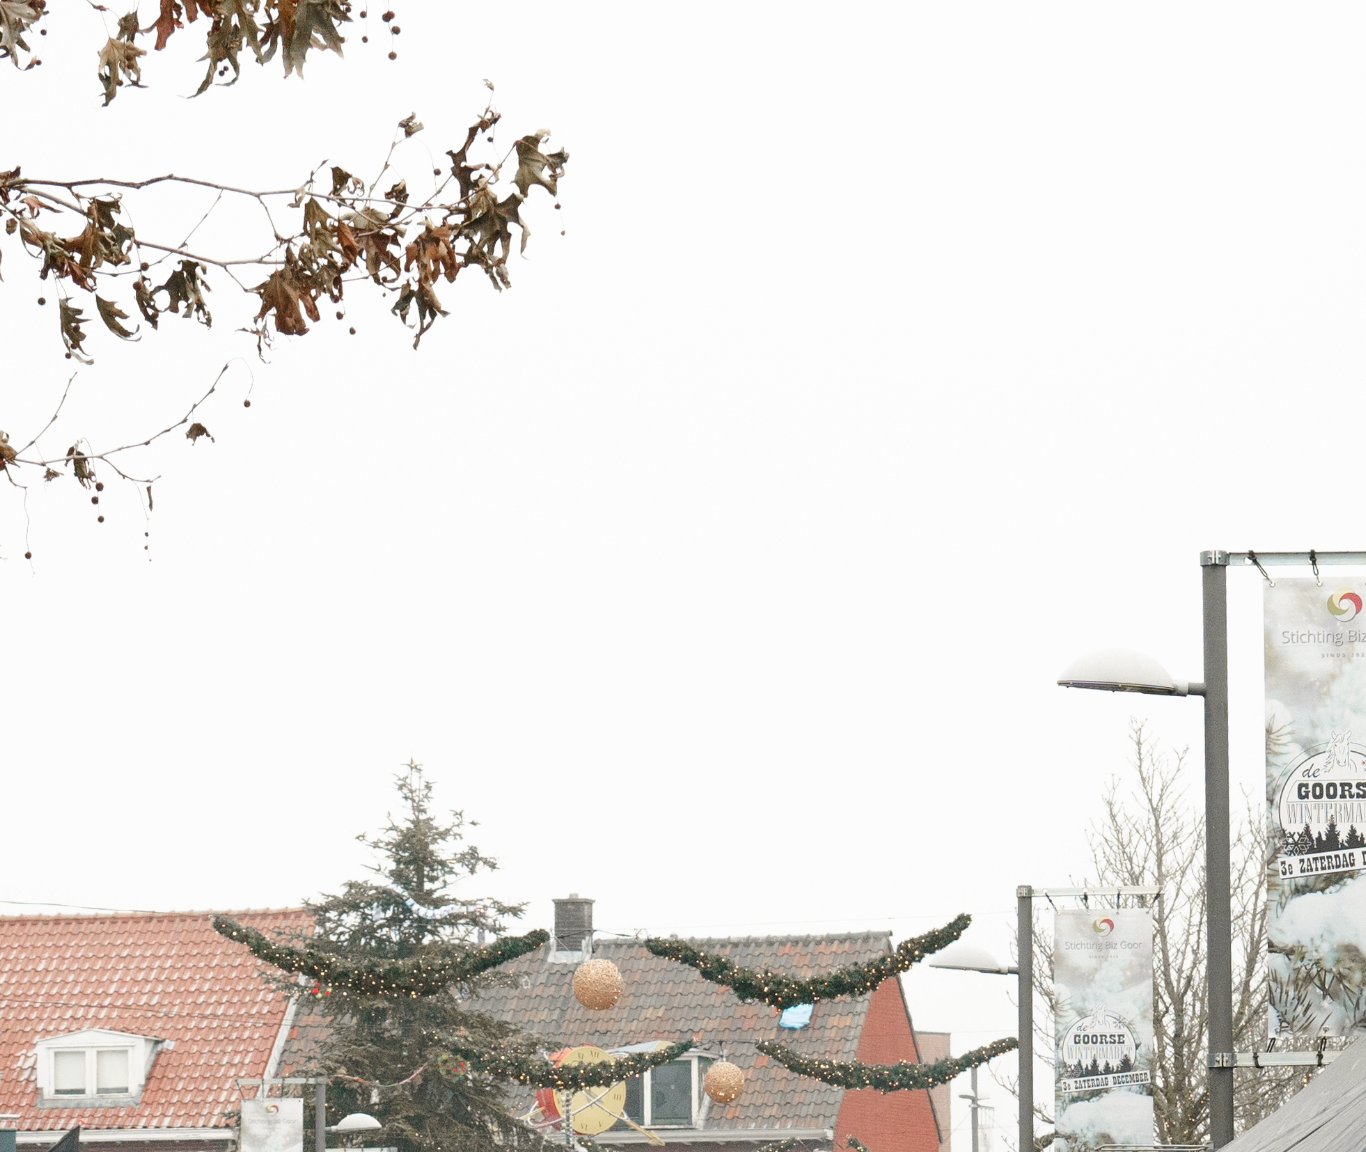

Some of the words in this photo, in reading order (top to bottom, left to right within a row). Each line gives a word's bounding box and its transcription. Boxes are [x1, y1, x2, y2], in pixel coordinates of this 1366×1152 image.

[1281, 630, 1343, 647] Stichting
[1302, 763, 1320, 778] de
[1280, 860, 1293, 876] 3e
[1299, 852, 1355, 873] ZATERDAG
[1065, 941, 1103, 951] Stichting
[1120, 940, 1143, 949] Goor
[1073, 1034, 1125, 1045] GOORSE
[1062, 1081, 1071, 1091] 3e
[1074, 1077, 1109, 1090] ZATERDAG
[1112, 1072, 1149, 1085] DECEMBER
